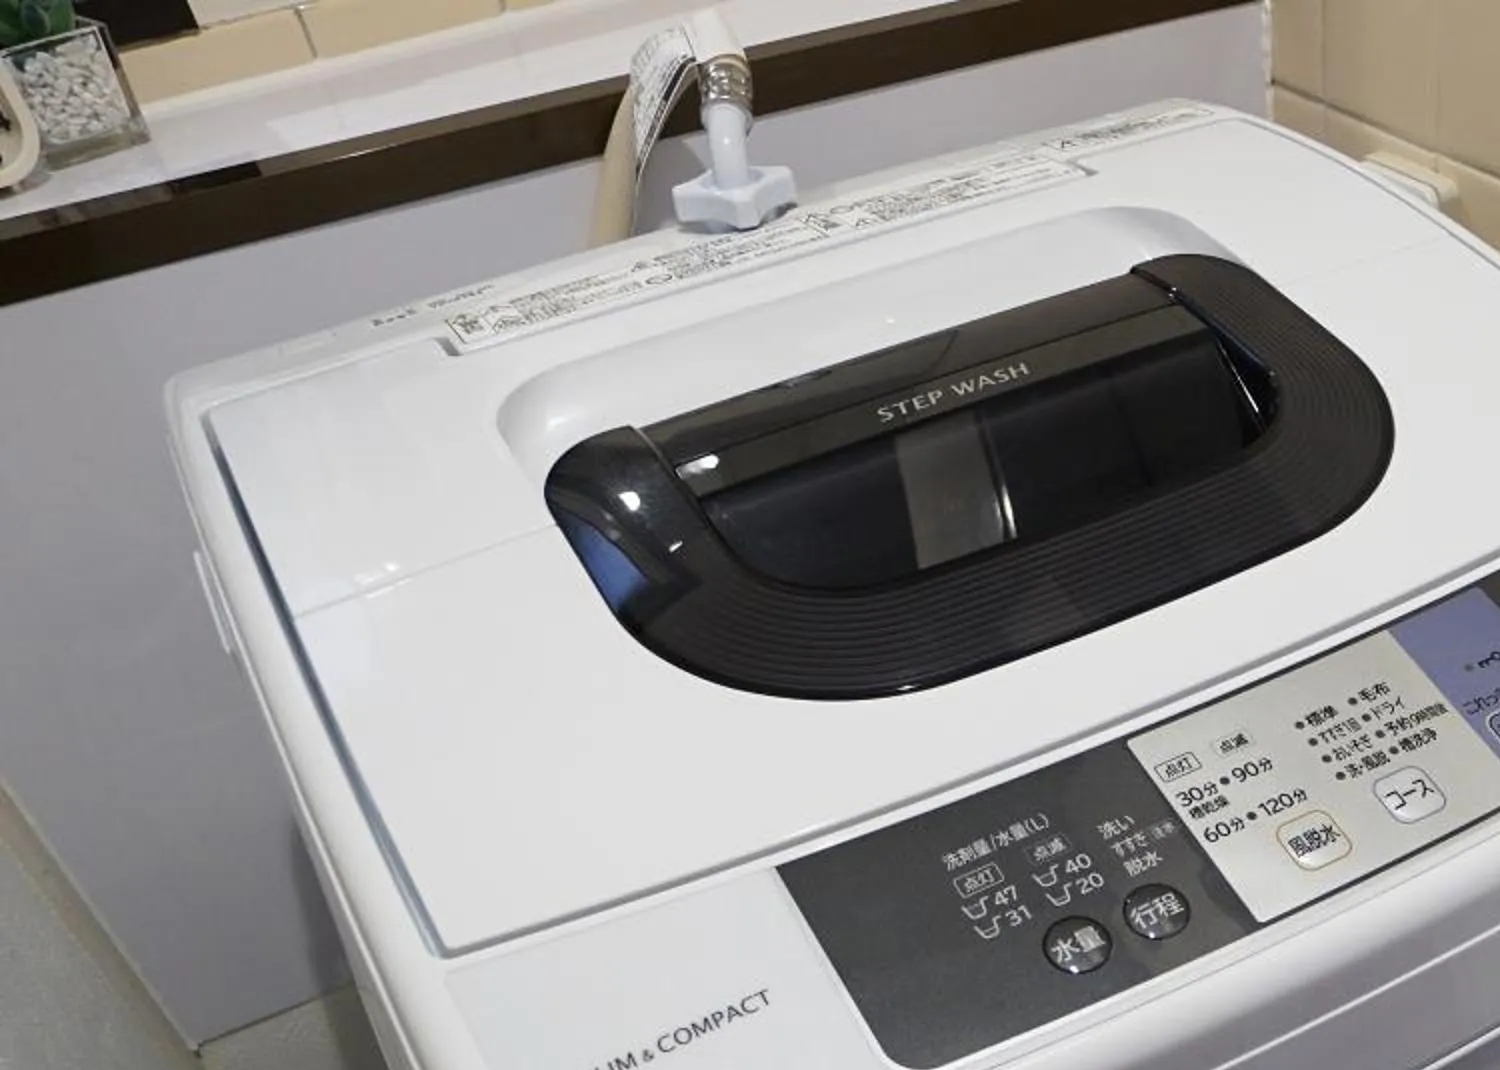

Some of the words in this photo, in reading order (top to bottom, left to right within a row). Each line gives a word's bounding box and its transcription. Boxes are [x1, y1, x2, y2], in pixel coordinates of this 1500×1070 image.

[877, 390, 943, 423] STEP
[951, 362, 1030, 397] WASH
[1358, 682, 1391, 703] 毛布
[1369, 696, 1405, 721] ドライ
[1385, 778, 1435, 810] コース
[994, 885, 1018, 908] 47
[1065, 853, 1092, 875] 40
[1005, 905, 1033, 927] 31
[1076, 873, 1104, 895] 20
[1129, 892, 1184, 929] 行程
[643, 1050, 654, 1063] &
[657, 988, 771, 1054] COMPACT
